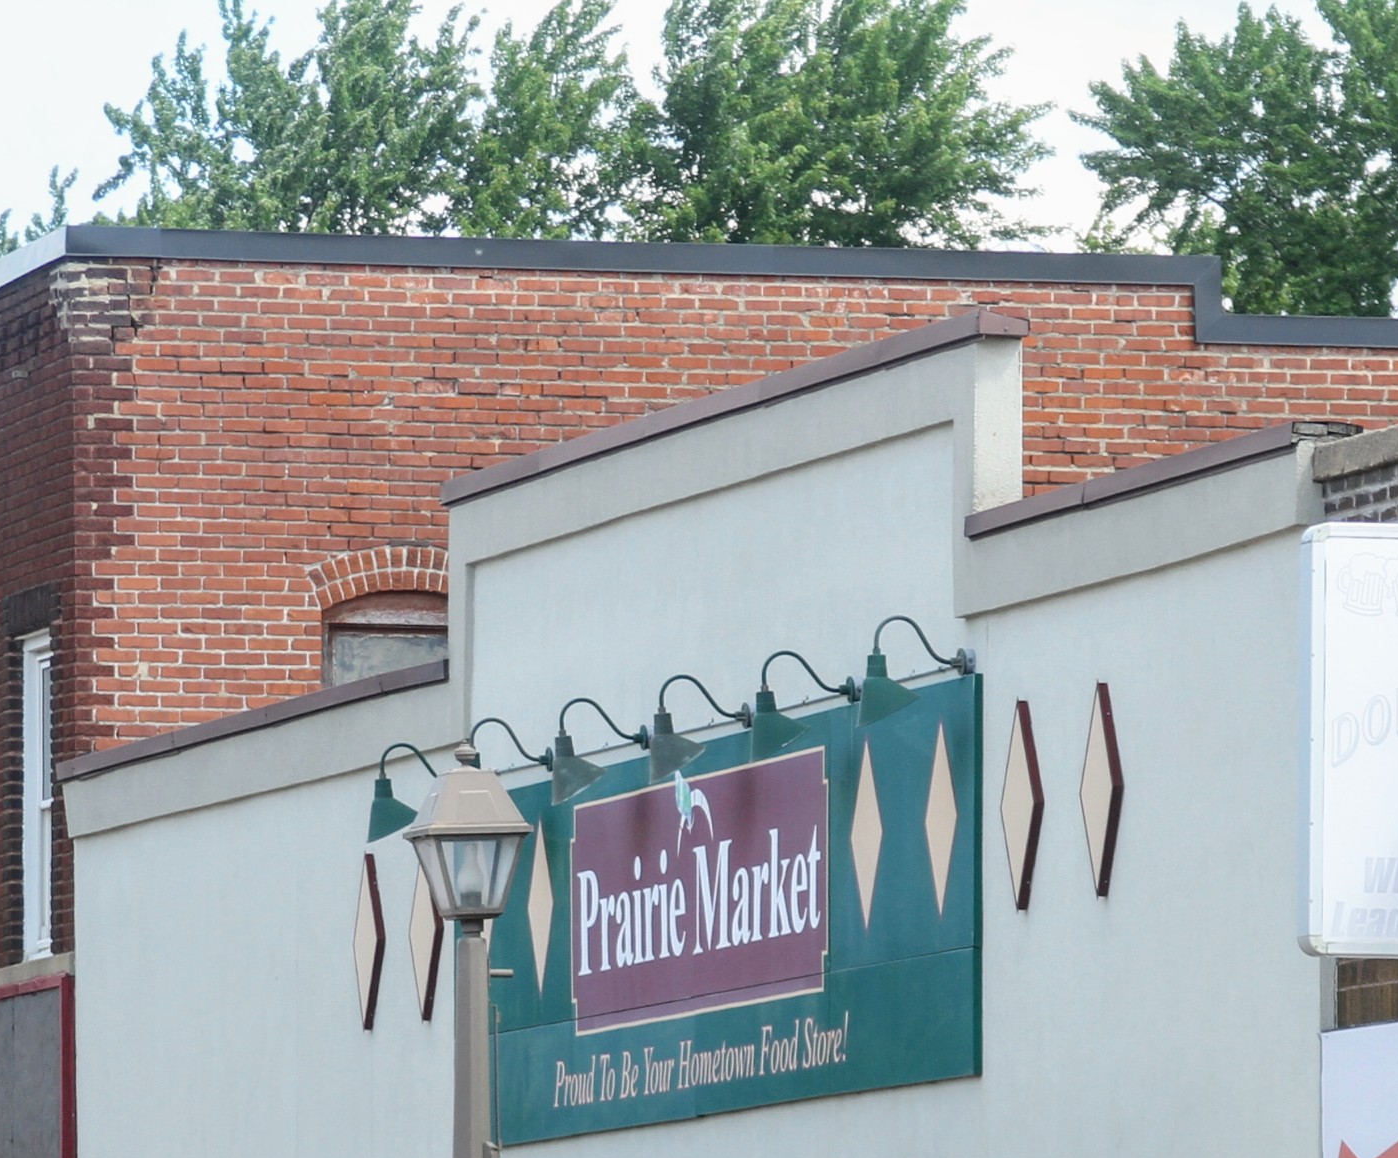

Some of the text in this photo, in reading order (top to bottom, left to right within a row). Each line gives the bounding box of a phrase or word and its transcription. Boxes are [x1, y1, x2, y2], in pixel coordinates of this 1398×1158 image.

[577, 824, 822, 976] Prairie Market
[553, 1010, 850, 1108] Proud To Be Your Hometown Food Store!
